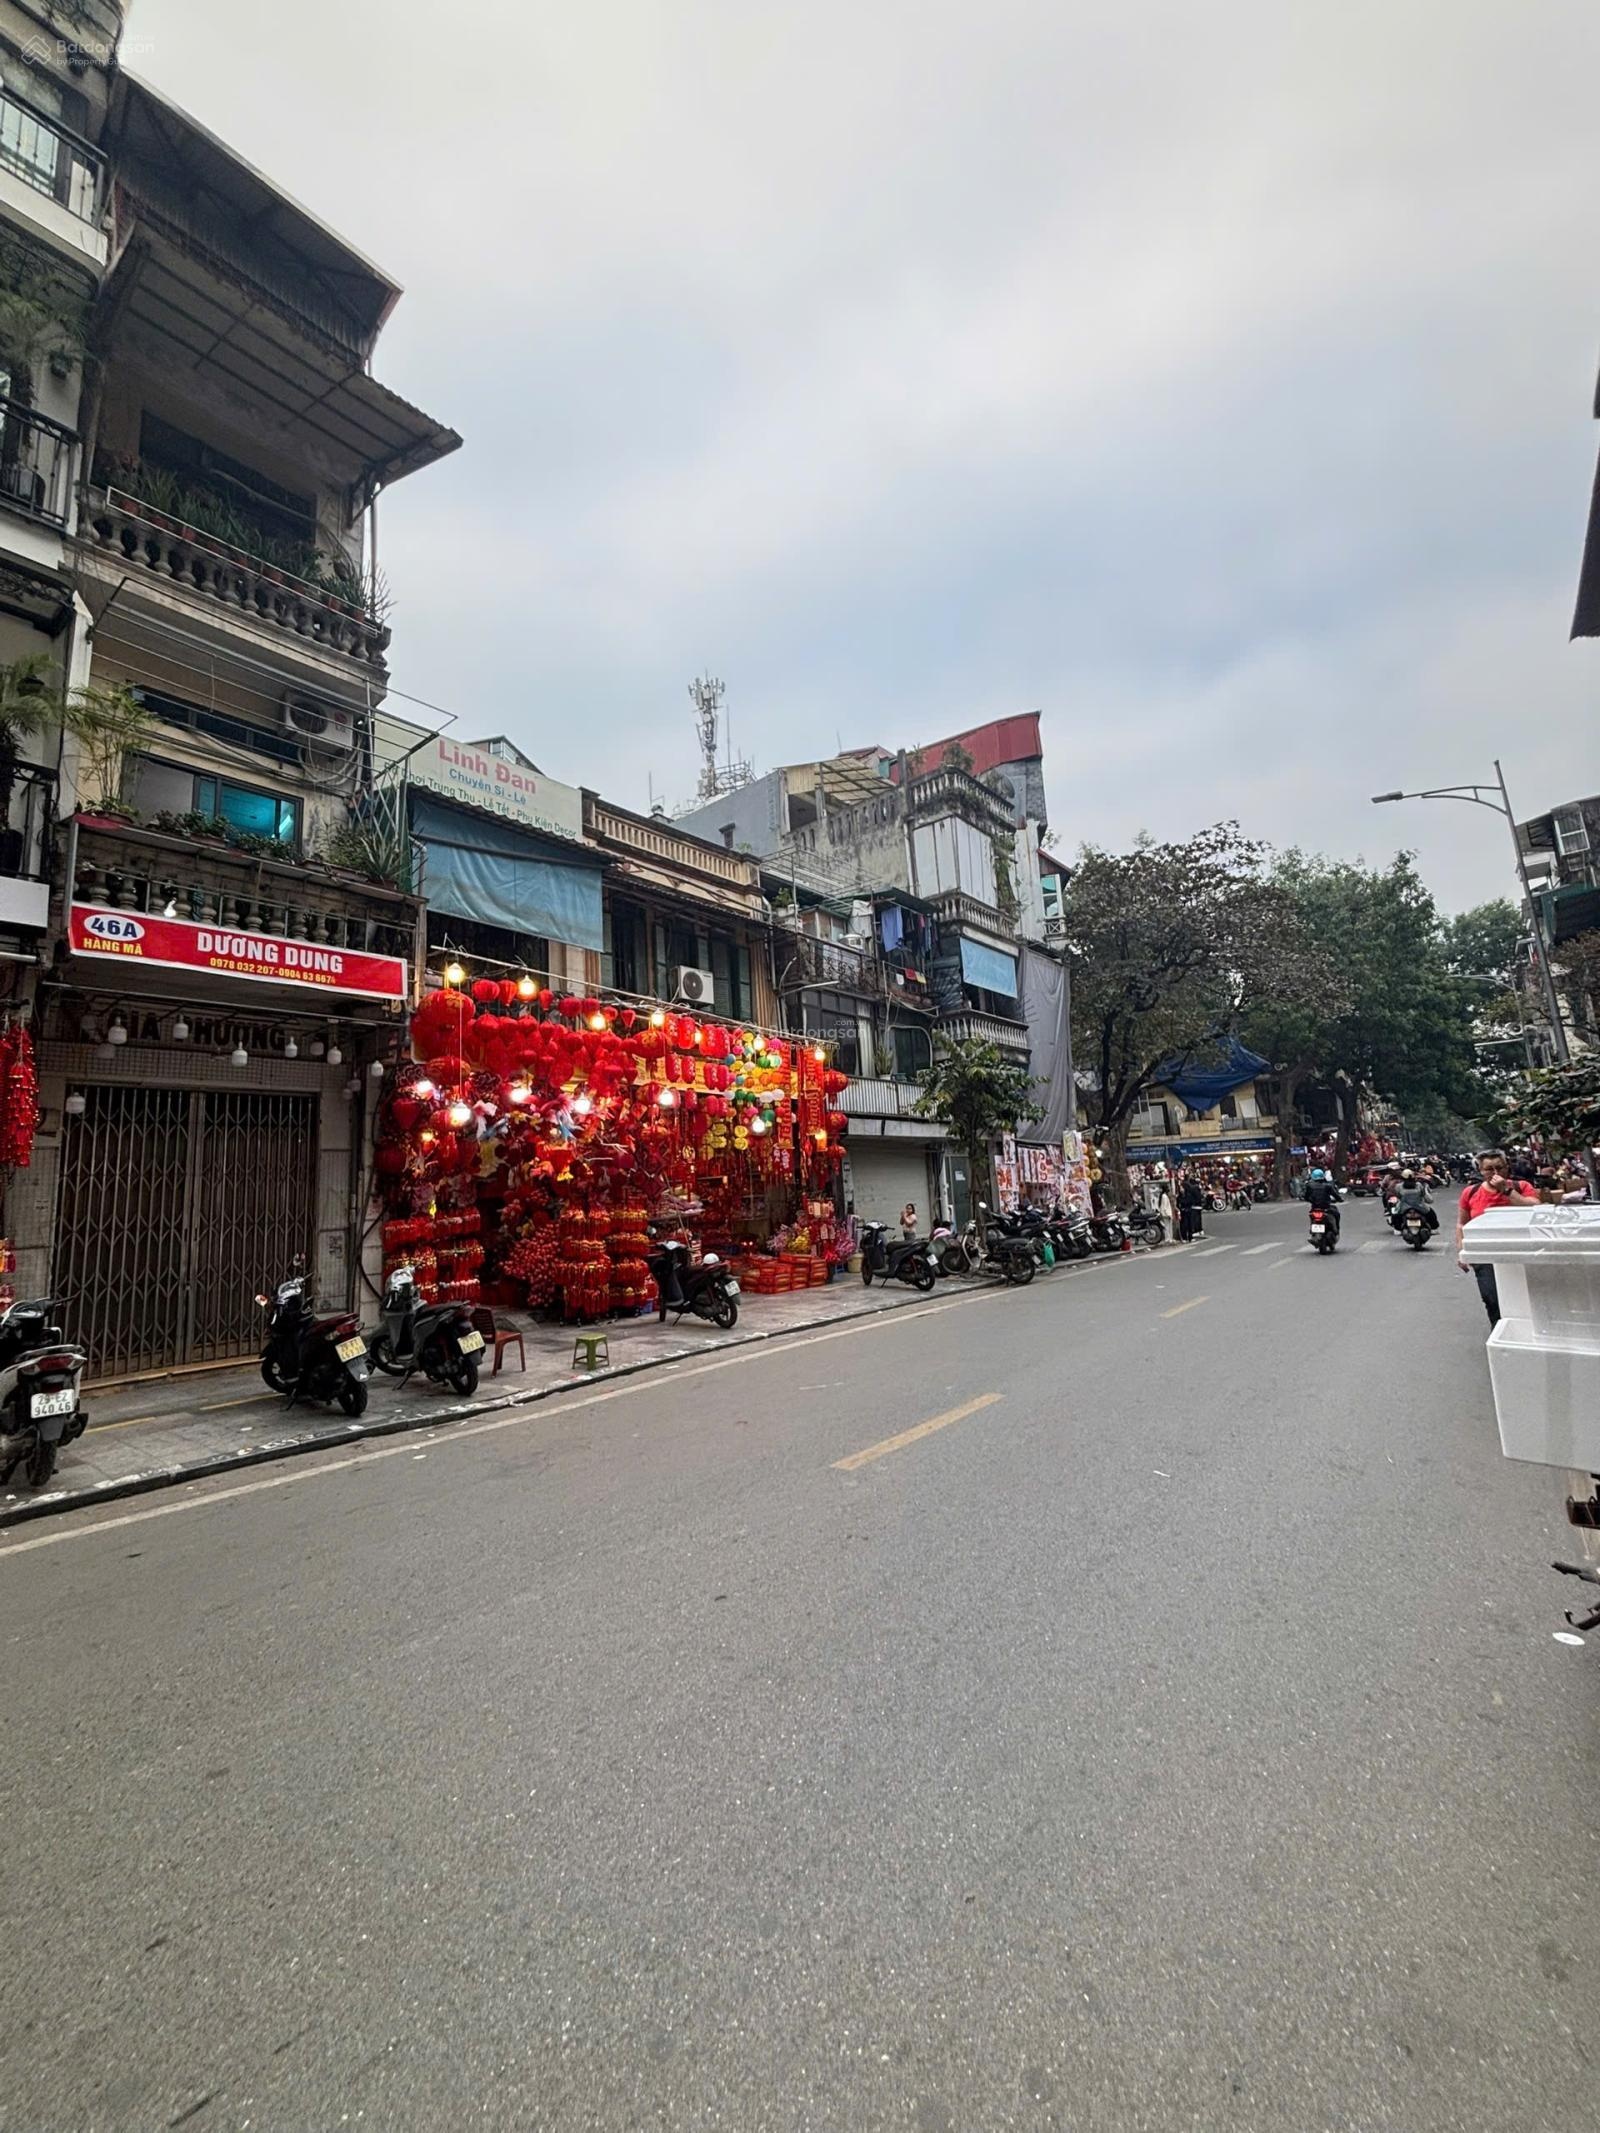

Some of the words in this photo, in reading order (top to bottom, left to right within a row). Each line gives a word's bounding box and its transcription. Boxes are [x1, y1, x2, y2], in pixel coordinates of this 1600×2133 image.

[440, 738, 488, 776] Linh
[495, 762, 536, 794] Đan
[449, 768, 491, 792] Chuyên
[427, 777, 455, 796] Trung
[457, 788, 475, 803] Thu
[554, 822, 577, 838] Decor
[91, 917, 138, 938] 46A
[83, 937, 120, 952] HÀNG
[197, 931, 279, 963] DƯƠNG
[285, 946, 343, 973] DUNG
[210, 957, 235, 969] 0978
[236, 961, 255, 973] 032
